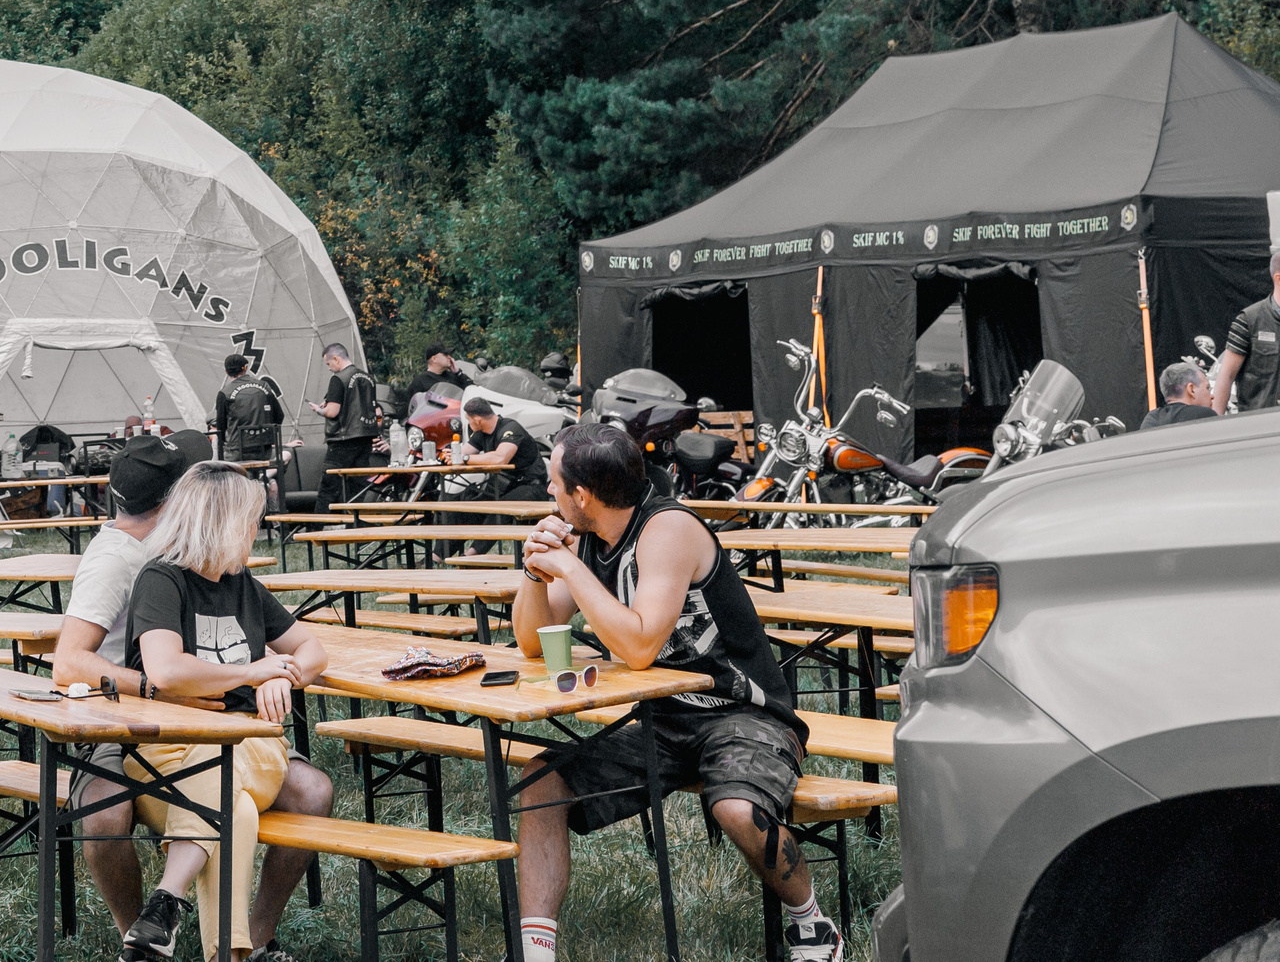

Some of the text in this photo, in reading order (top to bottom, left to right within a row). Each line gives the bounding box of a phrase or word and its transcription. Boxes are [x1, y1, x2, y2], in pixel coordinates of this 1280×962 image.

[952, 216, 1109, 242] SKIF FOREVER FIGHT TOGETHER
[852, 231, 905, 248] SKIF MC 1%
[693, 238, 813, 264] SKIF FOREVER FIGHT TOGETHER
[608, 256, 628, 269] SKIF
[642, 256, 653, 269] 1%
[531, 937, 555, 952] VANS
